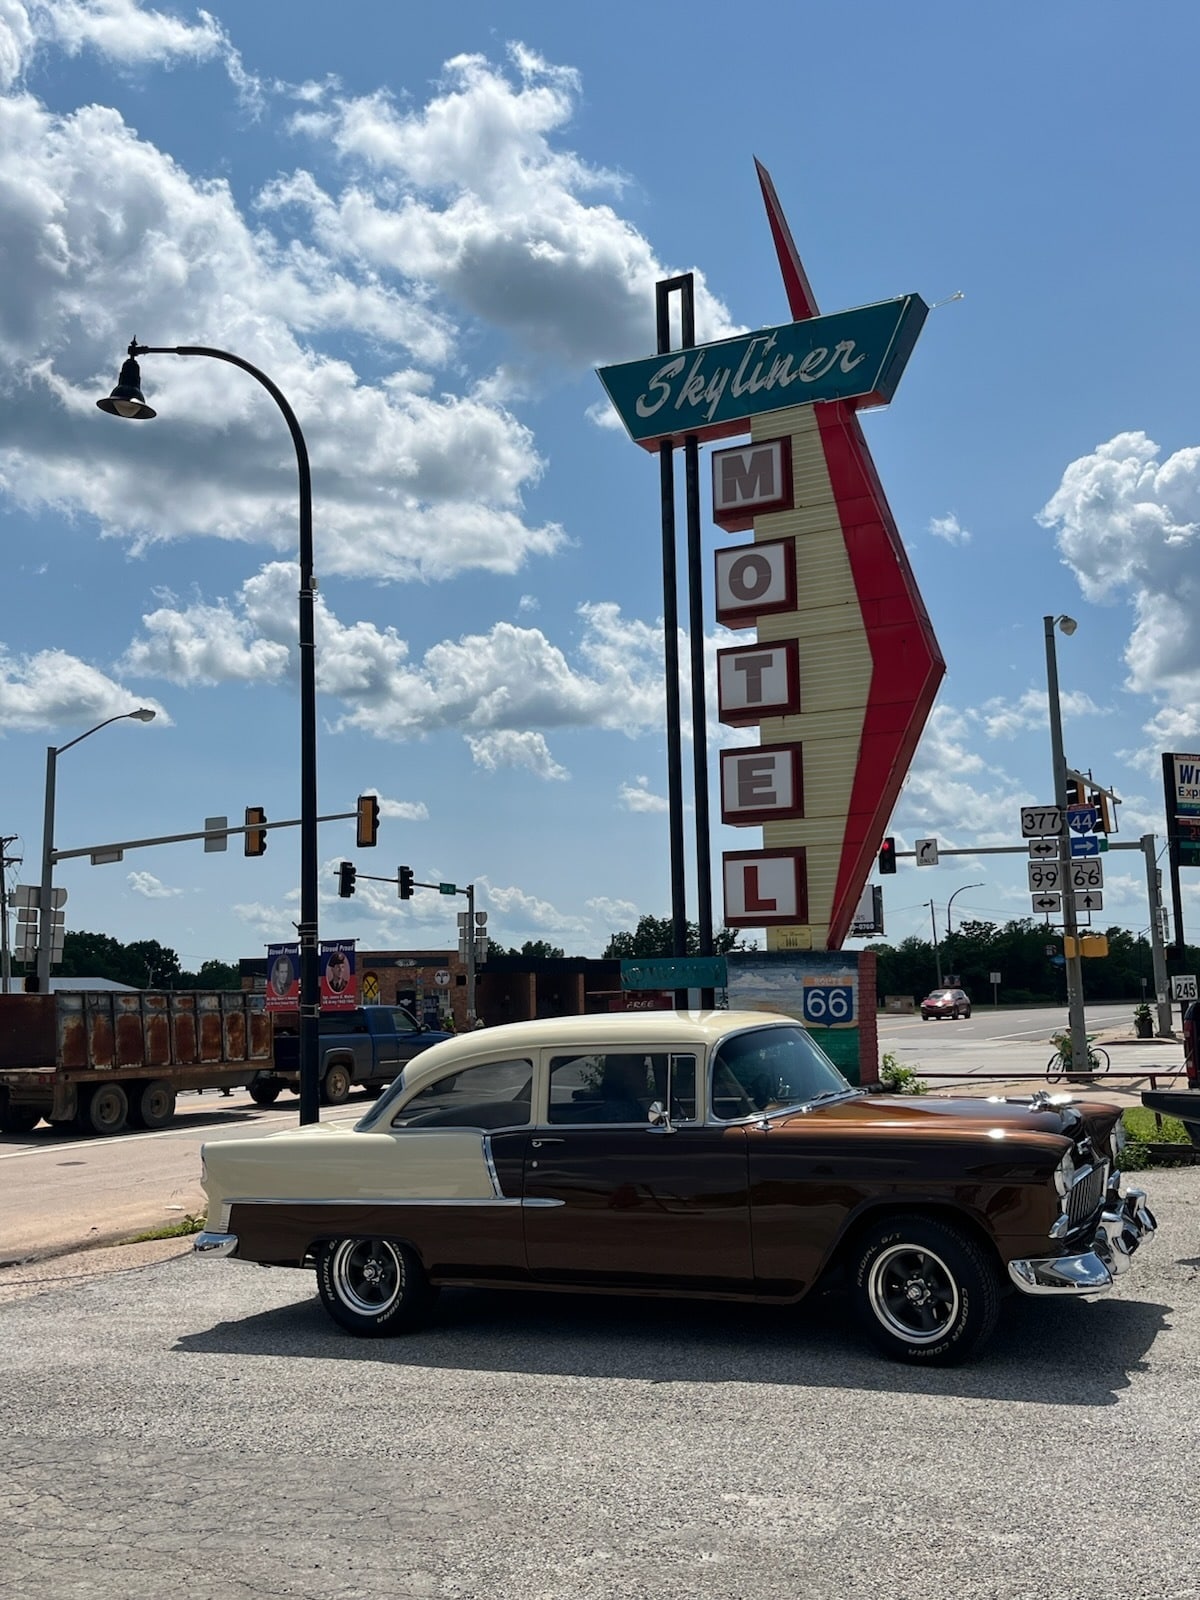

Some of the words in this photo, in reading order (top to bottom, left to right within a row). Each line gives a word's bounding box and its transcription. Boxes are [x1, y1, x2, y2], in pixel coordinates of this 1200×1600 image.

[635, 332, 866, 421] Skyliner
[721, 448, 776, 912] MOTEL
[1024, 812, 1059, 830] 377
[1070, 813, 1093, 829] 44
[1032, 871, 1057, 888] 99
[1074, 869, 1099, 886] 66
[1176, 982, 1196, 999] 245
[806, 988, 848, 1017] 66
[952, 1287, 969, 1341] COOPER
